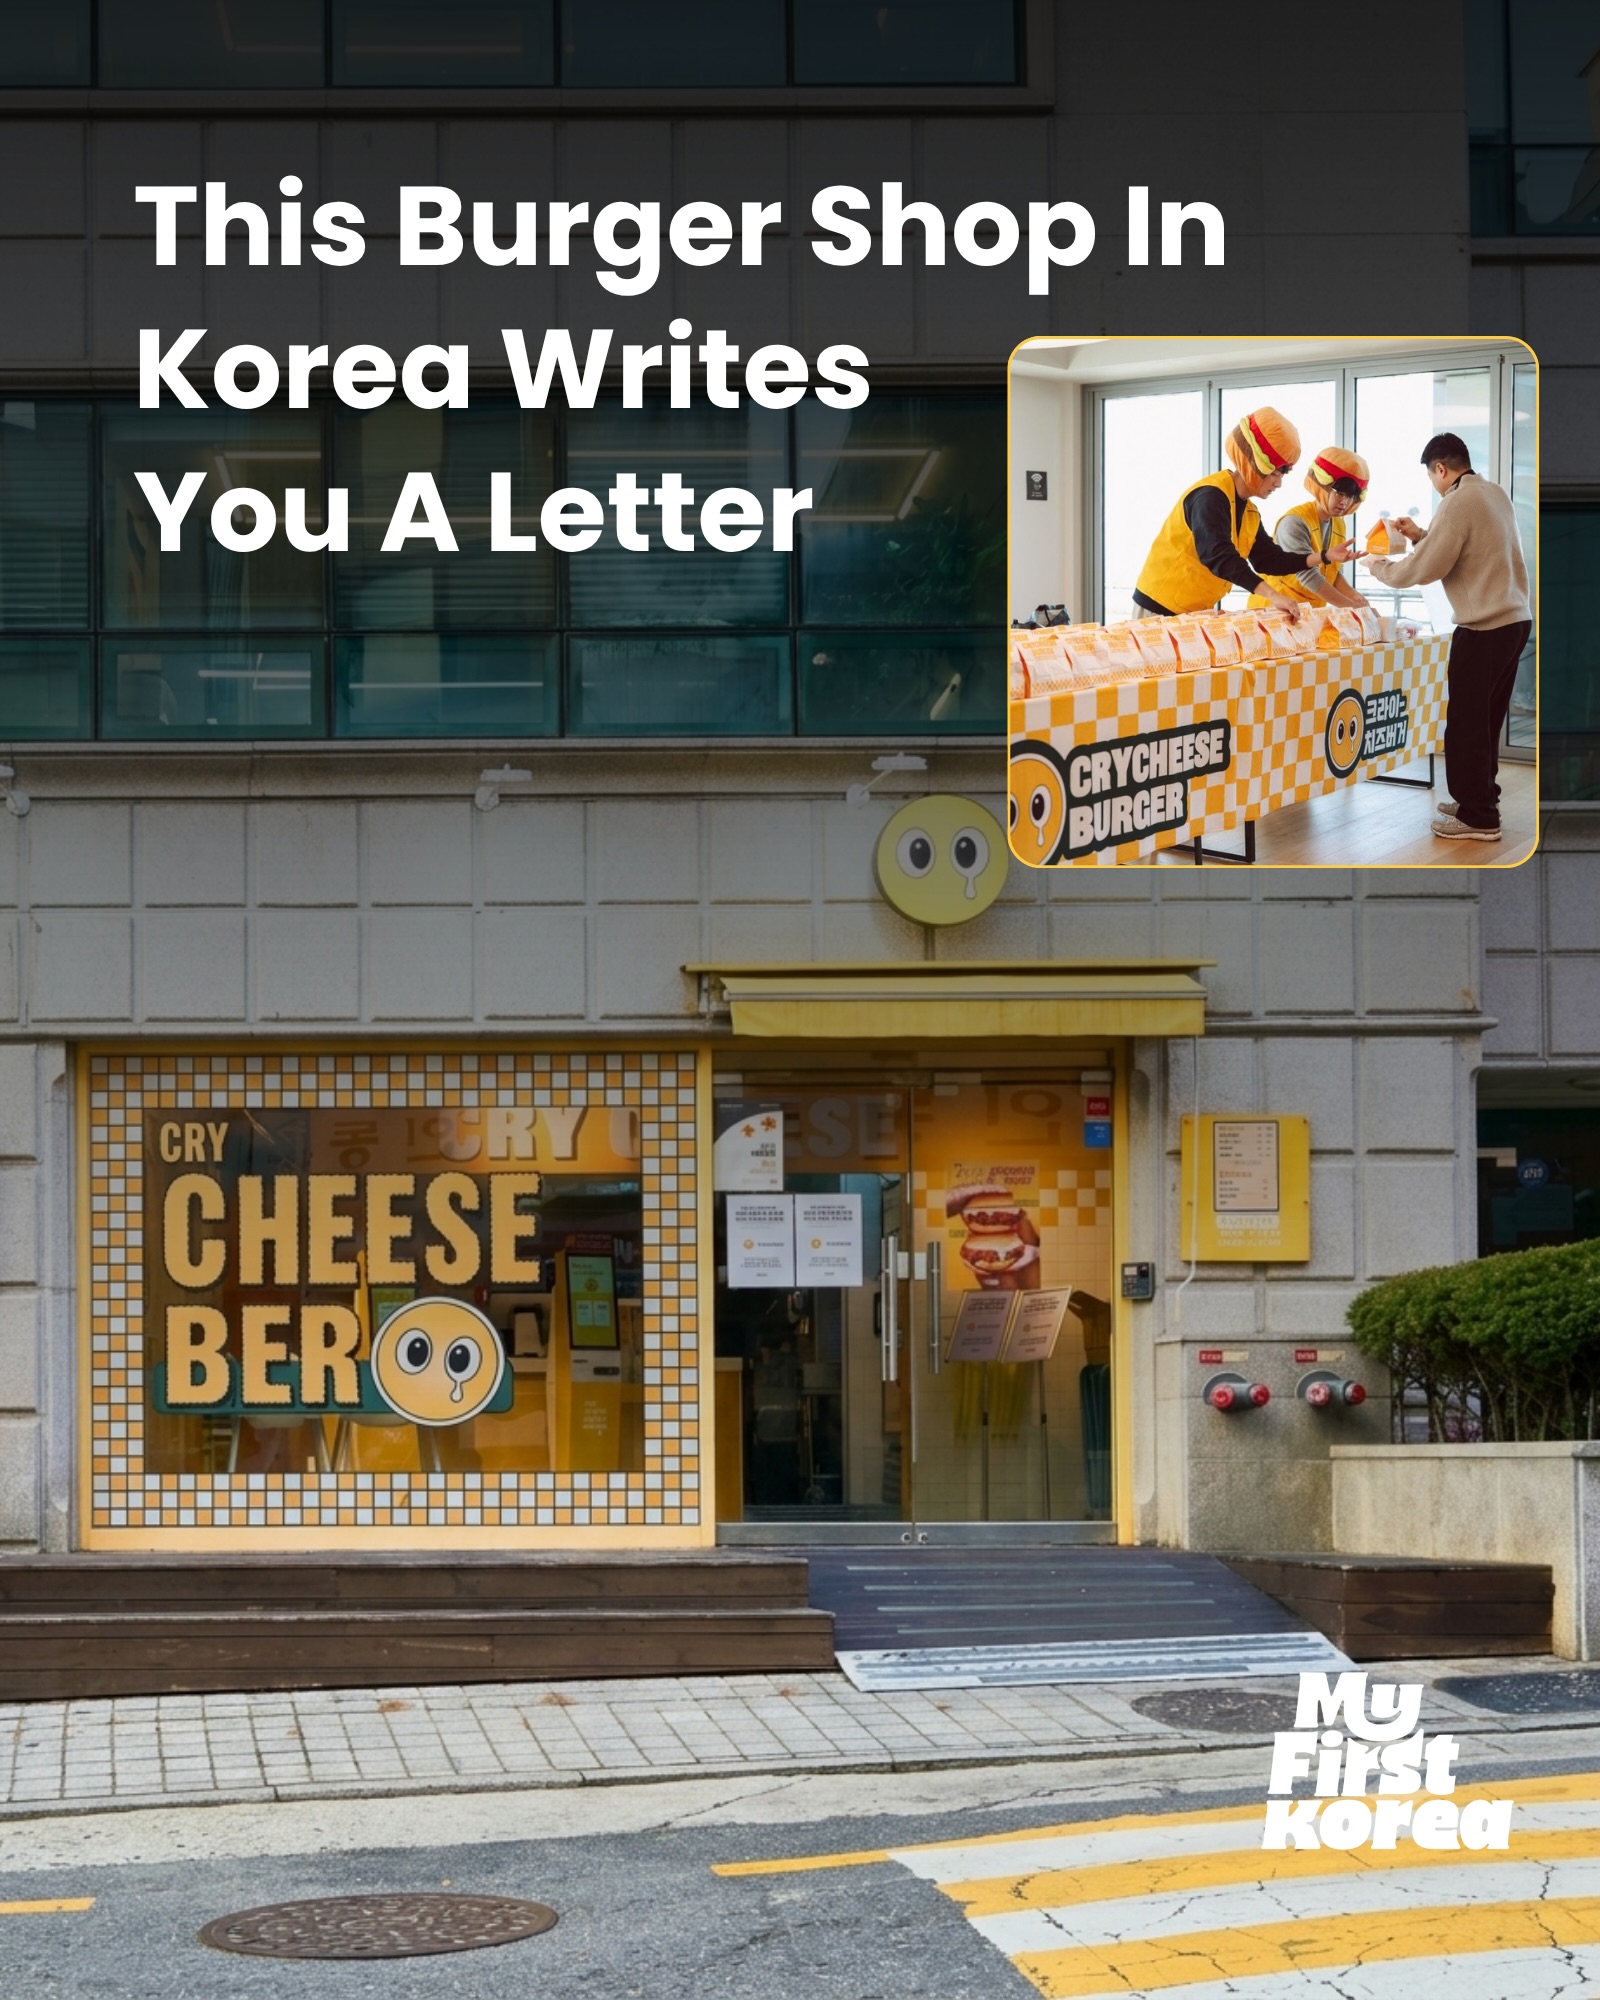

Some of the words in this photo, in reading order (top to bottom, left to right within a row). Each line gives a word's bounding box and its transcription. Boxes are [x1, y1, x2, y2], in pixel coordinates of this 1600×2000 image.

[1069, 728, 1226, 798] CRYCHEESE
[1363, 720, 1407, 755] 치즈버거
[1069, 782, 1185, 850] BURGER
[160, 1121, 229, 1162] CRY
[438, 1107, 588, 1161] CRY
[162, 1171, 541, 1289] CHEESE
[165, 1304, 363, 1406] BER
